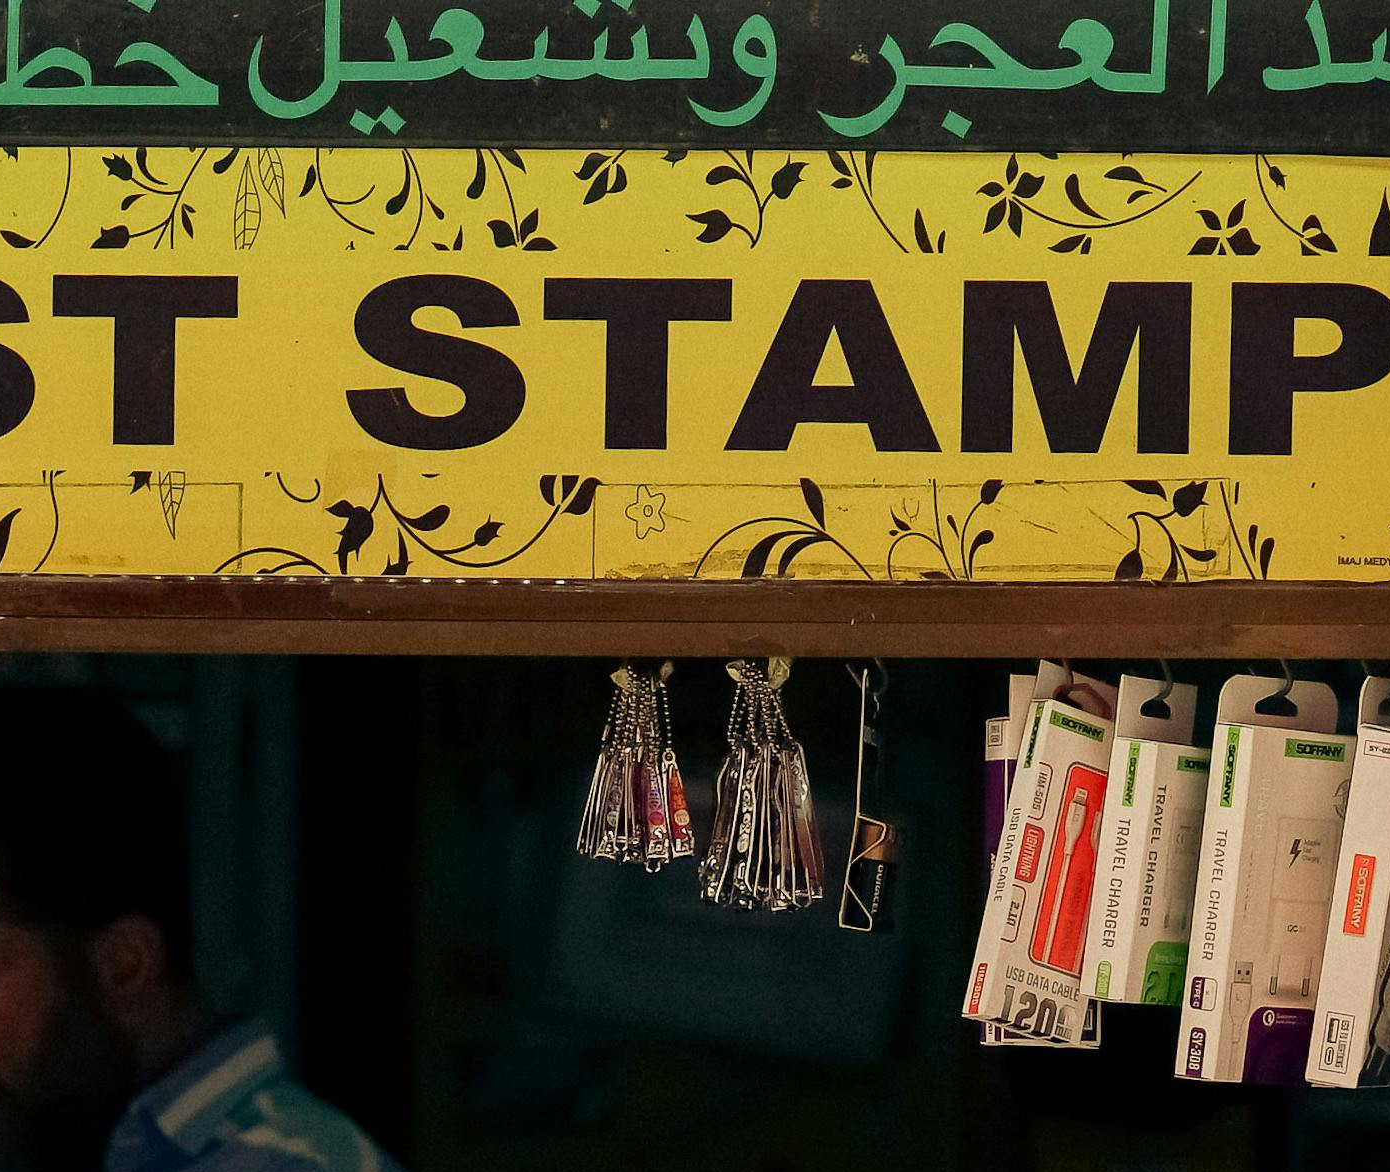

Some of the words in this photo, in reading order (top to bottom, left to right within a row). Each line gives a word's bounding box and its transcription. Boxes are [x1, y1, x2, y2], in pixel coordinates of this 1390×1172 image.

[1060, 716, 1103, 741] SOFFANY
[1296, 742, 1344, 758] SOFFANY
[1151, 784, 1168, 843] TRAVEL
[1018, 829, 1039, 880] LIGHTNING
[1111, 818, 1132, 873] TRAVEL
[1211, 829, 1229, 886] TRAVEL
[1101, 876, 1124, 949] CHARGER
[1139, 845, 1159, 928] CHARGER
[1349, 866, 1370, 930] SOFFANY
[1201, 889, 1221, 962] CHARGER
[1026, 971, 1049, 992] DATA
[1000, 984, 1058, 1038] 120
[1187, 1030, 1205, 1074] SY-308
